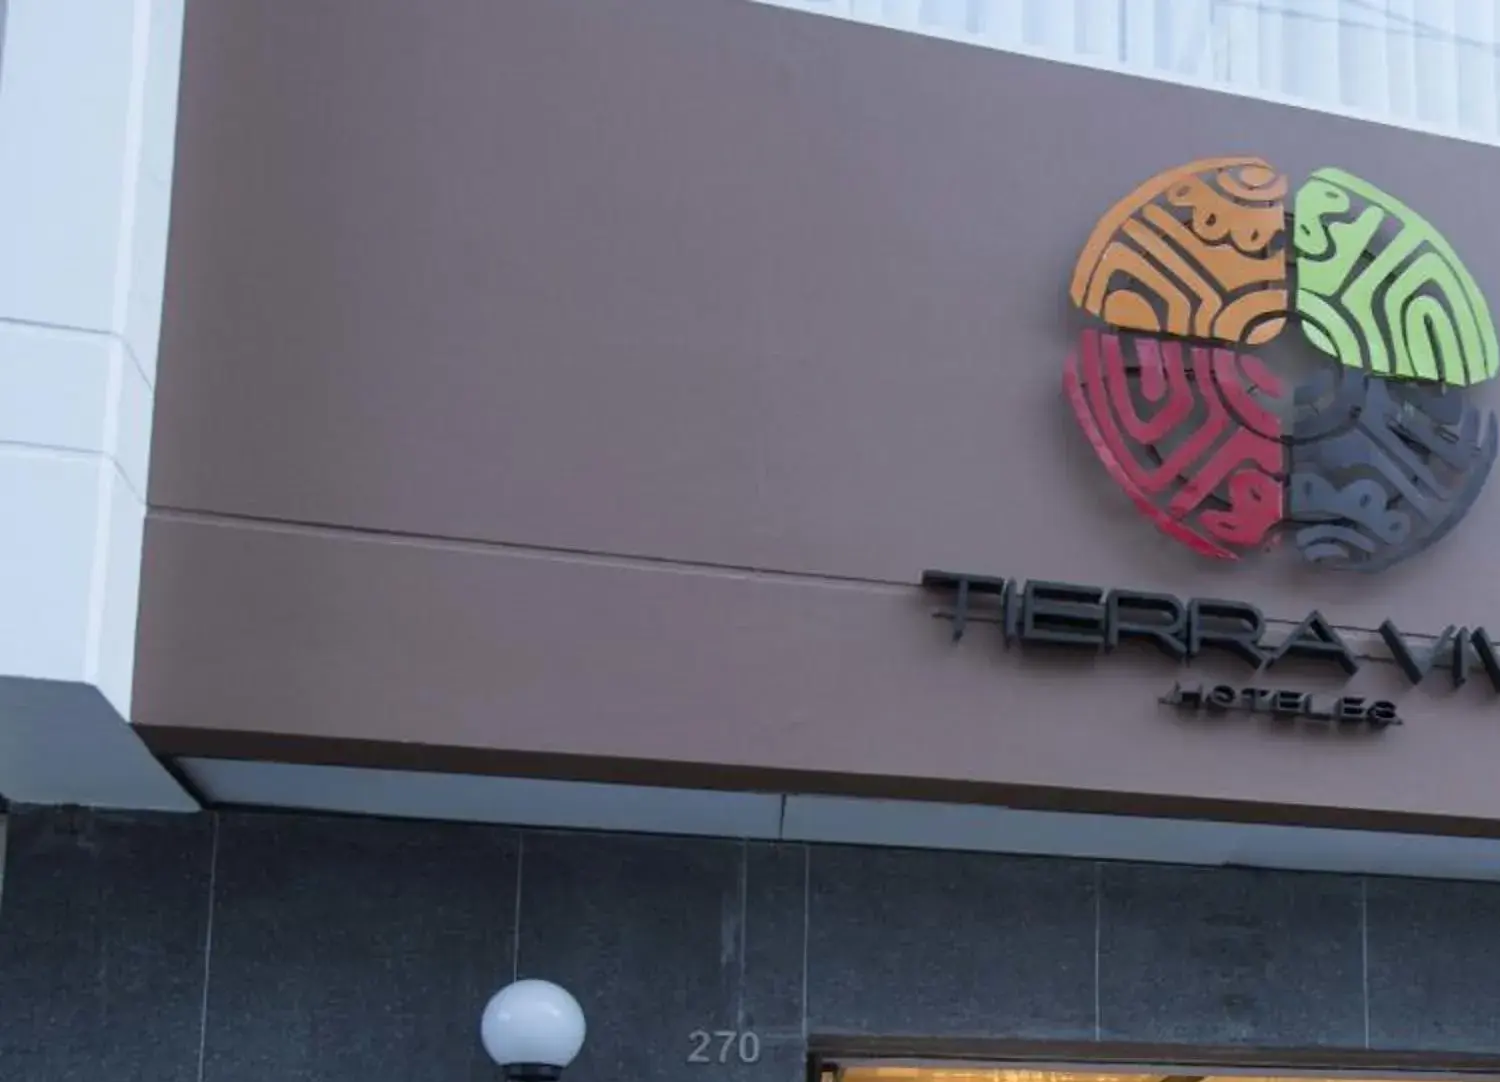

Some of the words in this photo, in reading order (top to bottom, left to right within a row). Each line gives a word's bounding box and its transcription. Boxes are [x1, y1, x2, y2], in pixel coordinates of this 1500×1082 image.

[921, 568, 1361, 676] TIERRA
[1160, 680, 1402, 726] HOTELES
[687, 1030, 760, 1063] 270
